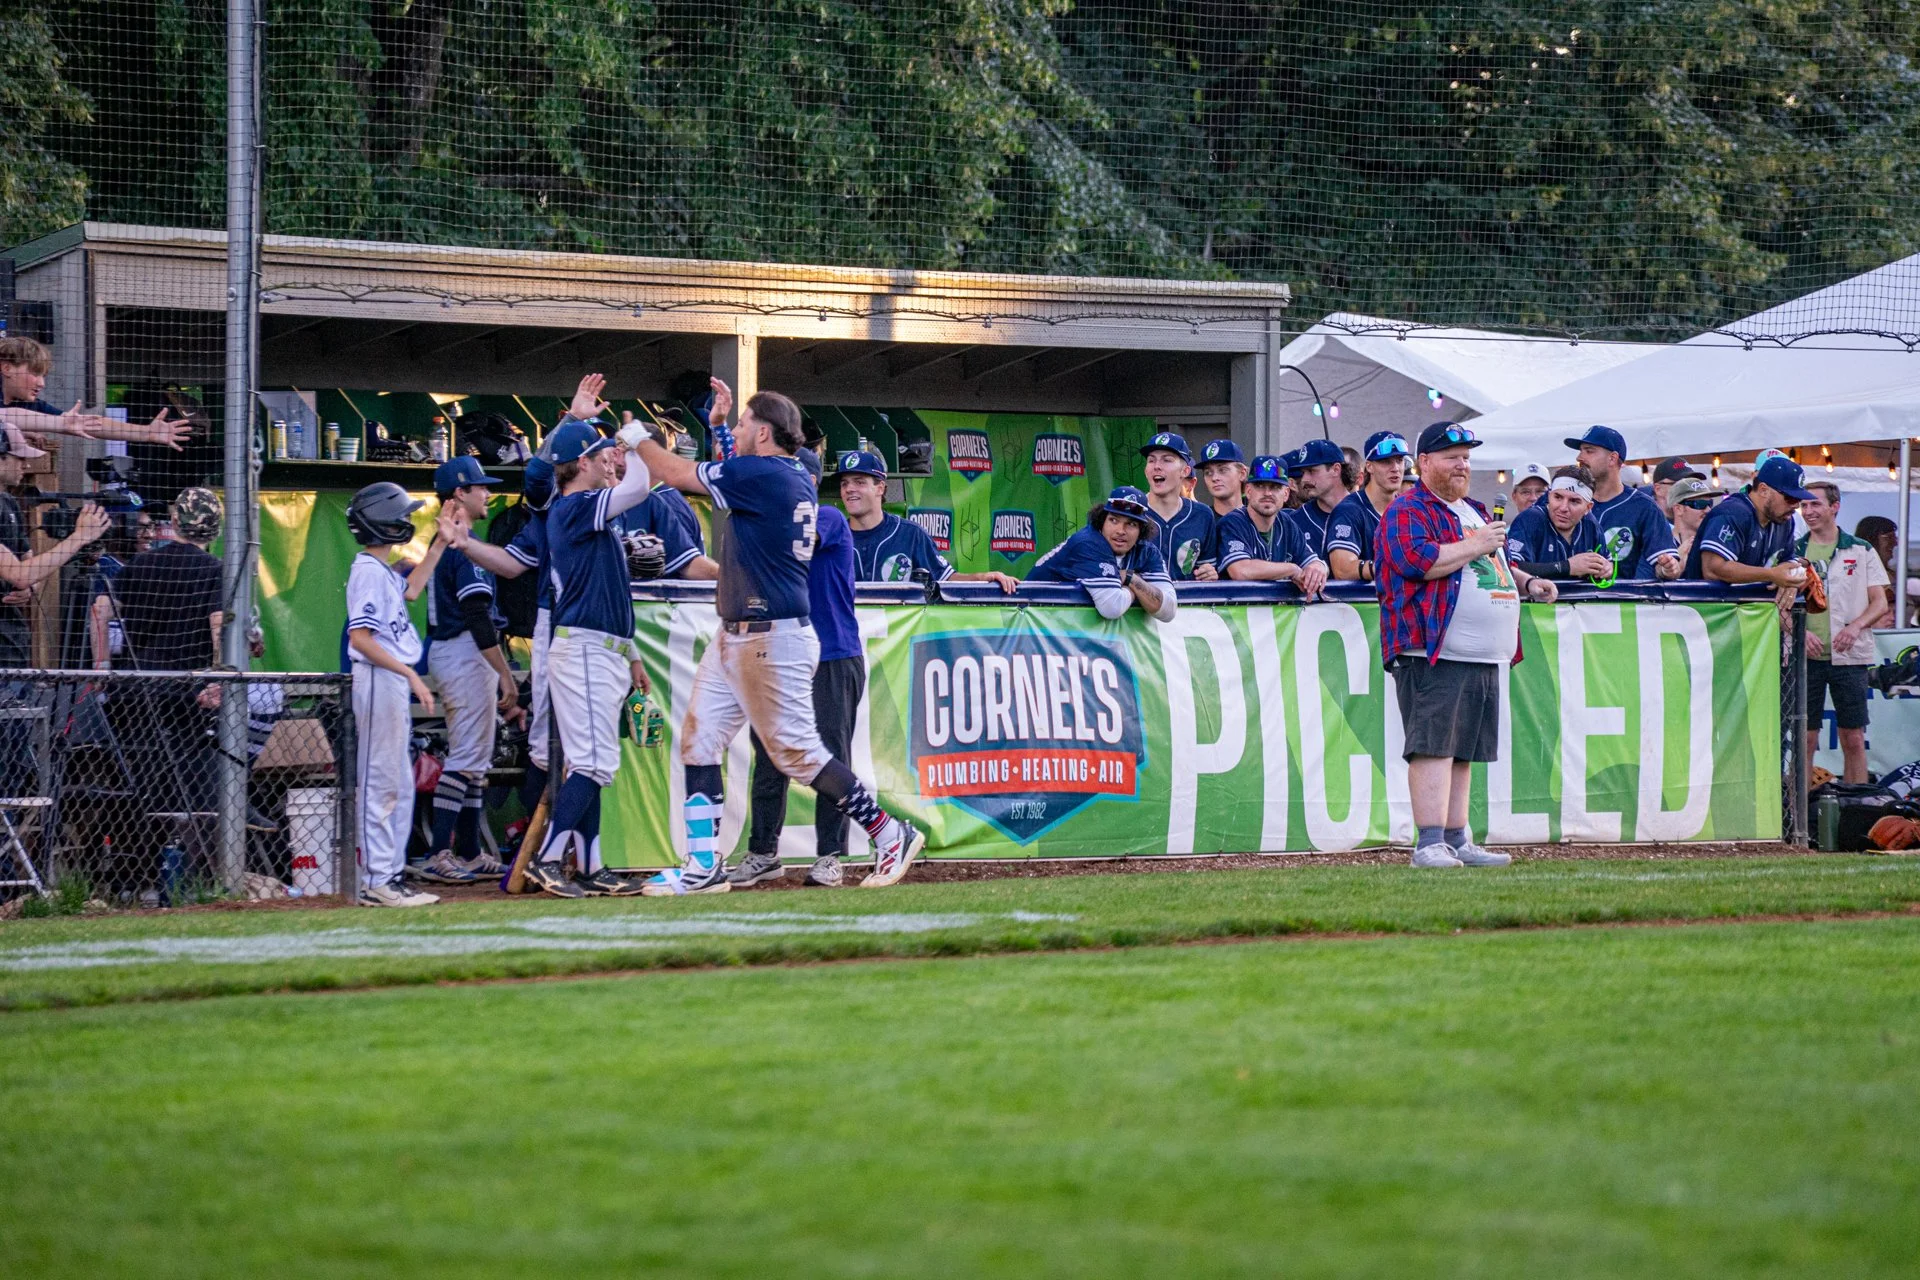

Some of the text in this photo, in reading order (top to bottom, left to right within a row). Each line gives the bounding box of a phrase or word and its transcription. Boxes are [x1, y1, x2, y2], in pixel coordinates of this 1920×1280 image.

[950, 434, 989, 459] CORNEL'S
[1035, 438, 1081, 463] CORNEL'S
[792, 500, 820, 561] 3
[993, 515, 1032, 539] CORNEL'S
[924, 654, 1124, 748] CORNEL'S
[1157, 602, 1714, 854] PICLED
[928, 758, 1124, 789] PLUMBING HEATING AIR
[1026, 801, 1047, 820] 1982
